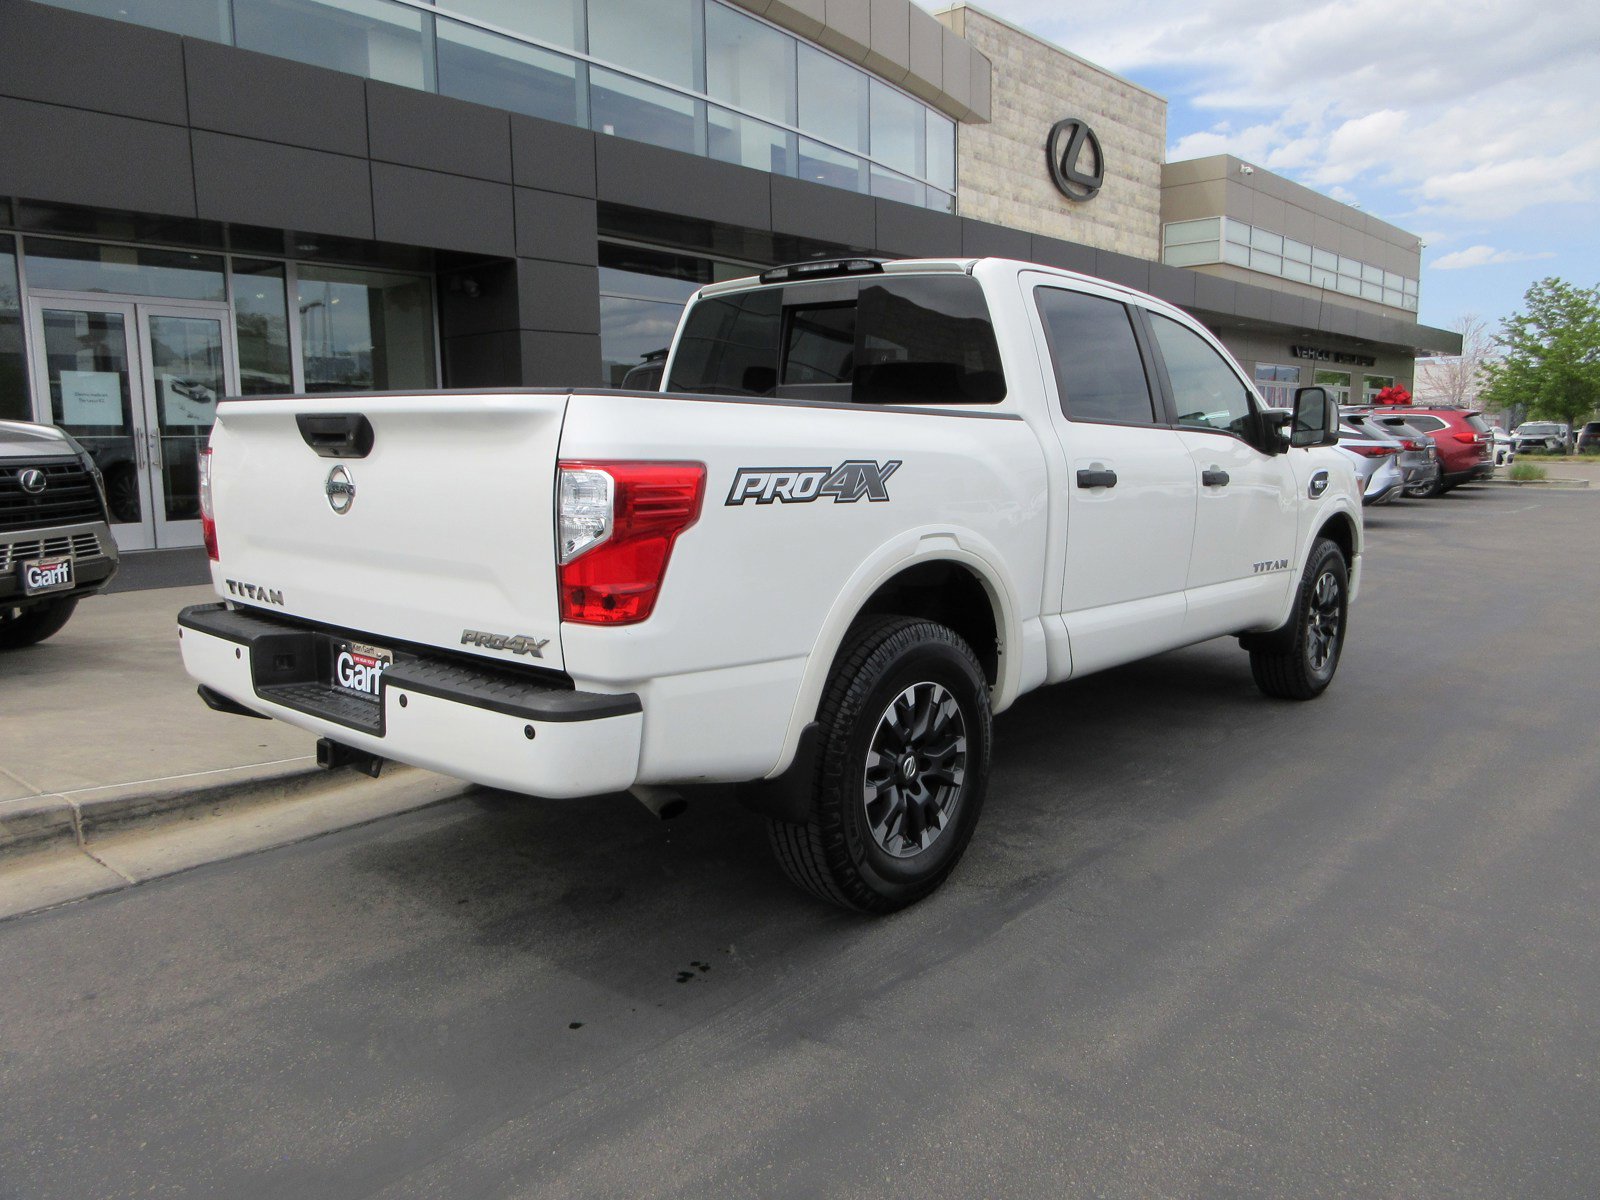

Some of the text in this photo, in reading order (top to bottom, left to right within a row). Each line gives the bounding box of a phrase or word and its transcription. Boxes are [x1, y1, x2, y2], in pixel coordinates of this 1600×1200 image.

[724, 459, 903, 507] PRO4X
[27, 562, 69, 588] Garff
[1252, 559, 1289, 574] TITAN
[225, 578, 285, 607] TITAN
[460, 628, 551, 660] PRO4X
